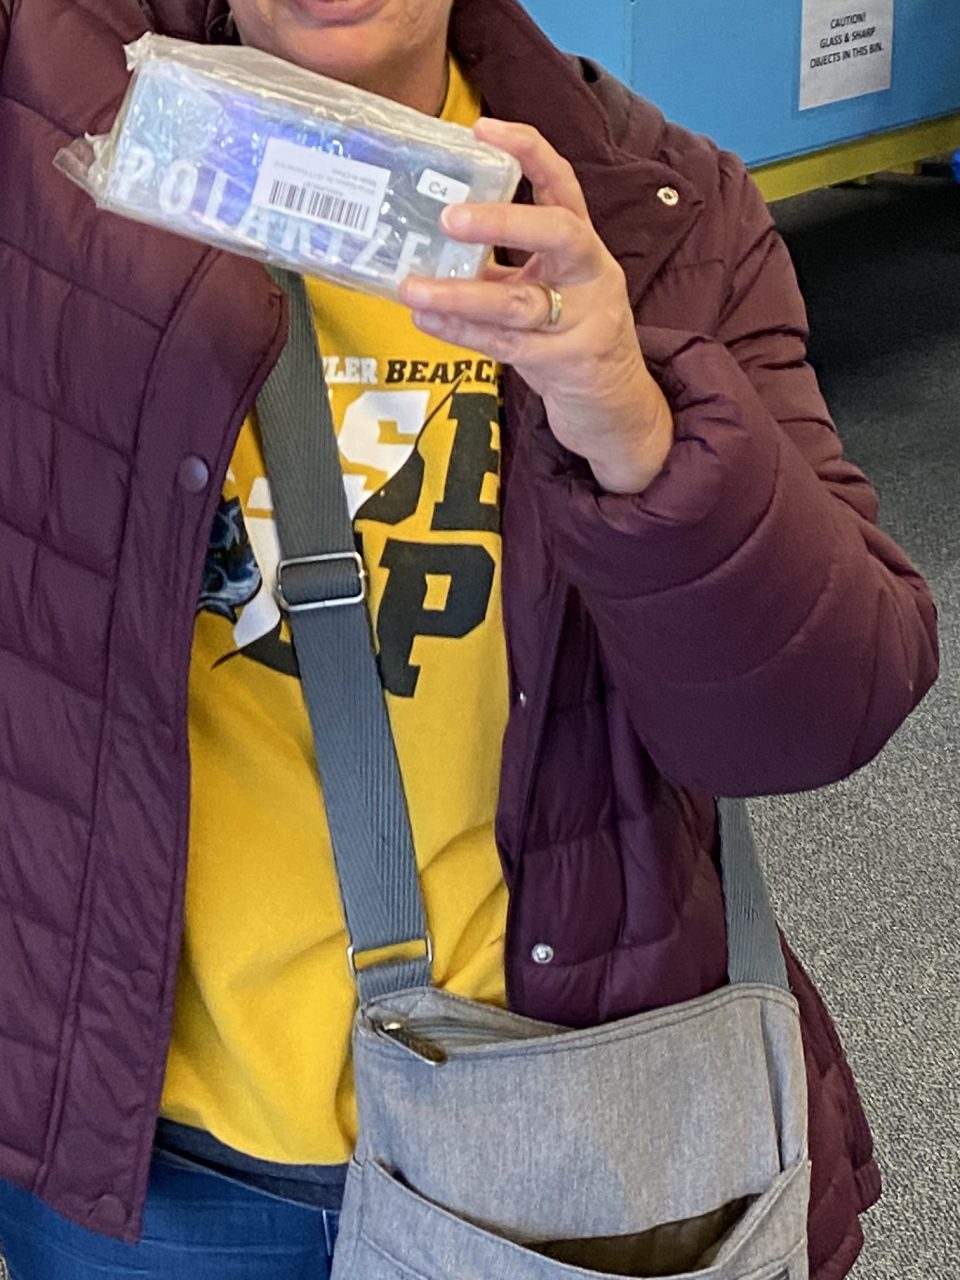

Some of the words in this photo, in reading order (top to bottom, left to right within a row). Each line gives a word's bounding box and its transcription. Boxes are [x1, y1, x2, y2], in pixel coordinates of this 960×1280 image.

[830, 12, 866, 29] CAUTION!
[820, 34, 842, 48] GLASS
[844, 32, 849, 43] &
[851, 26, 876, 41] SHARP
[810, 52, 841, 68] OBJECTS
[842, 50, 851, 61] IN
[852, 45, 868, 58] THIS
[428, 181, 448, 198] C4
[385, 358, 497, 384] BEARC
